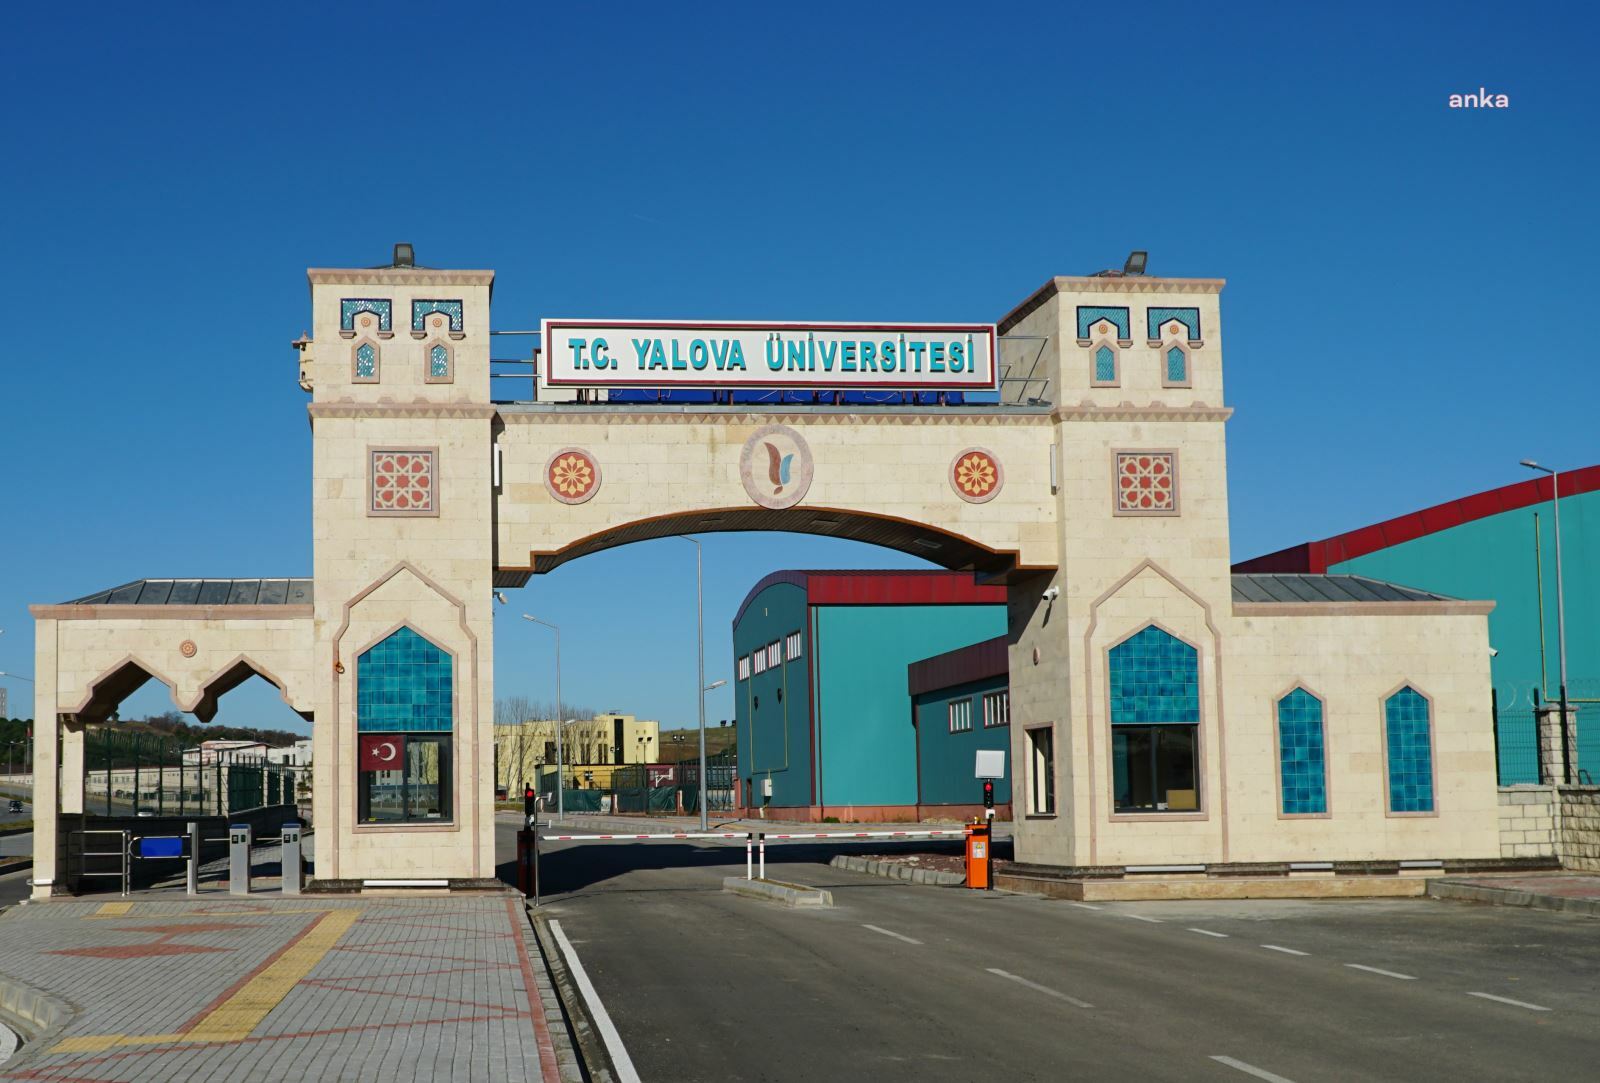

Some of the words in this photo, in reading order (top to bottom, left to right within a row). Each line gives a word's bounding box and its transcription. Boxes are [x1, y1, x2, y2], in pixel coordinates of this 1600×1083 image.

[569, 338, 618, 369] T.C.
[632, 339, 747, 371] YALOVA
[766, 332, 975, 373] ÜNİVERSİTESİ
